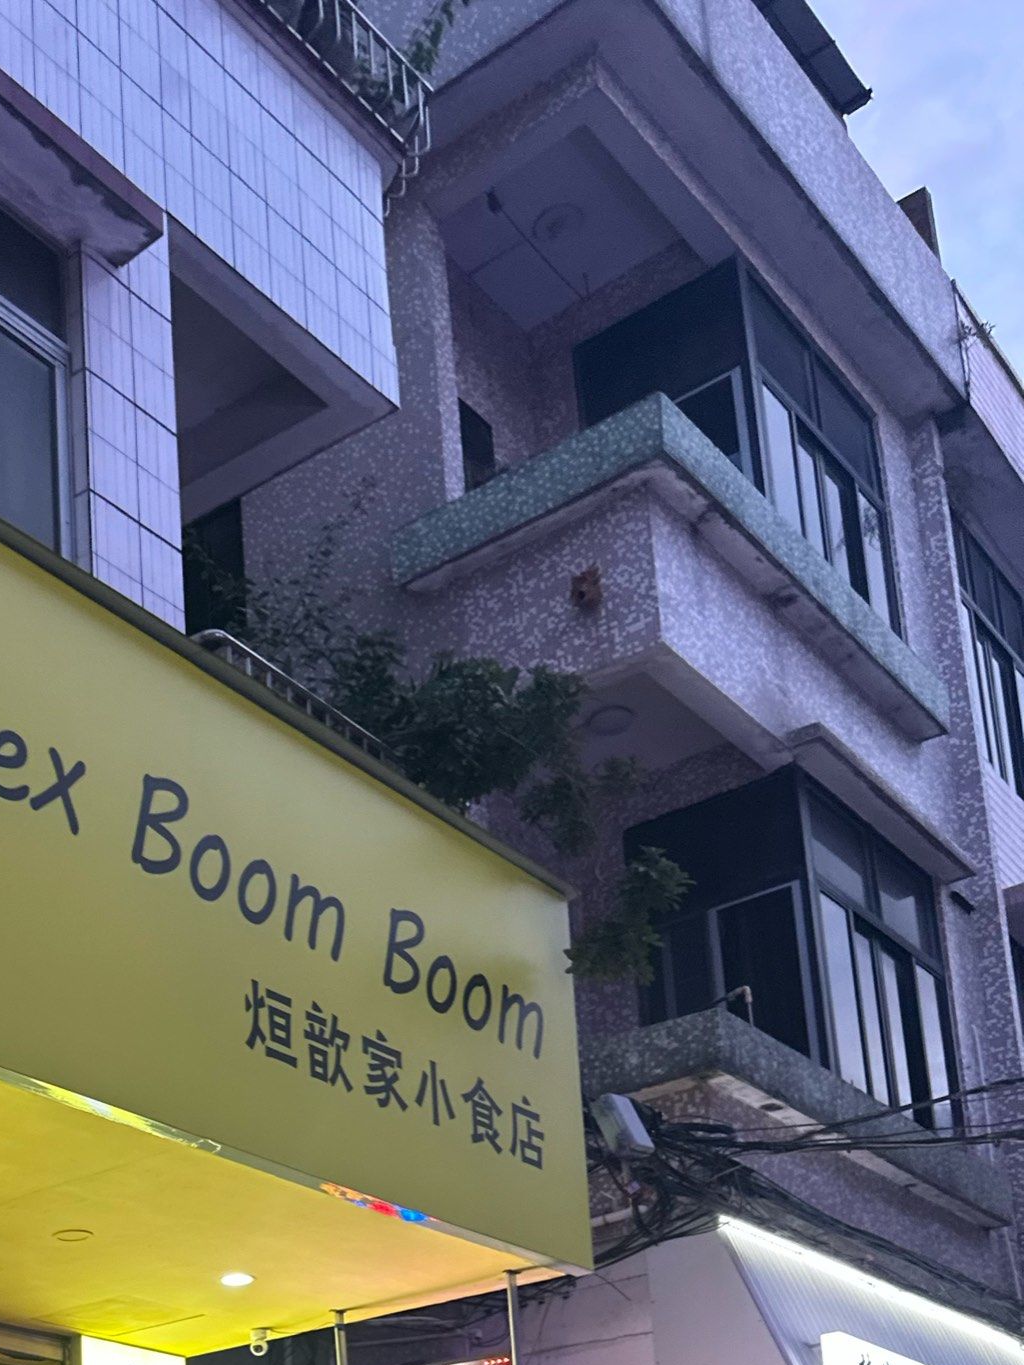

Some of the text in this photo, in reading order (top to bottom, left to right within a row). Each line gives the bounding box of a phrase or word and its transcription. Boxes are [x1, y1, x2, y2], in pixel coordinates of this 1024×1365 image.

[131, 773, 346, 962] Boom
[383, 908, 545, 1060] Boom
[245, 979, 546, 1170] 烜歆家小食店
